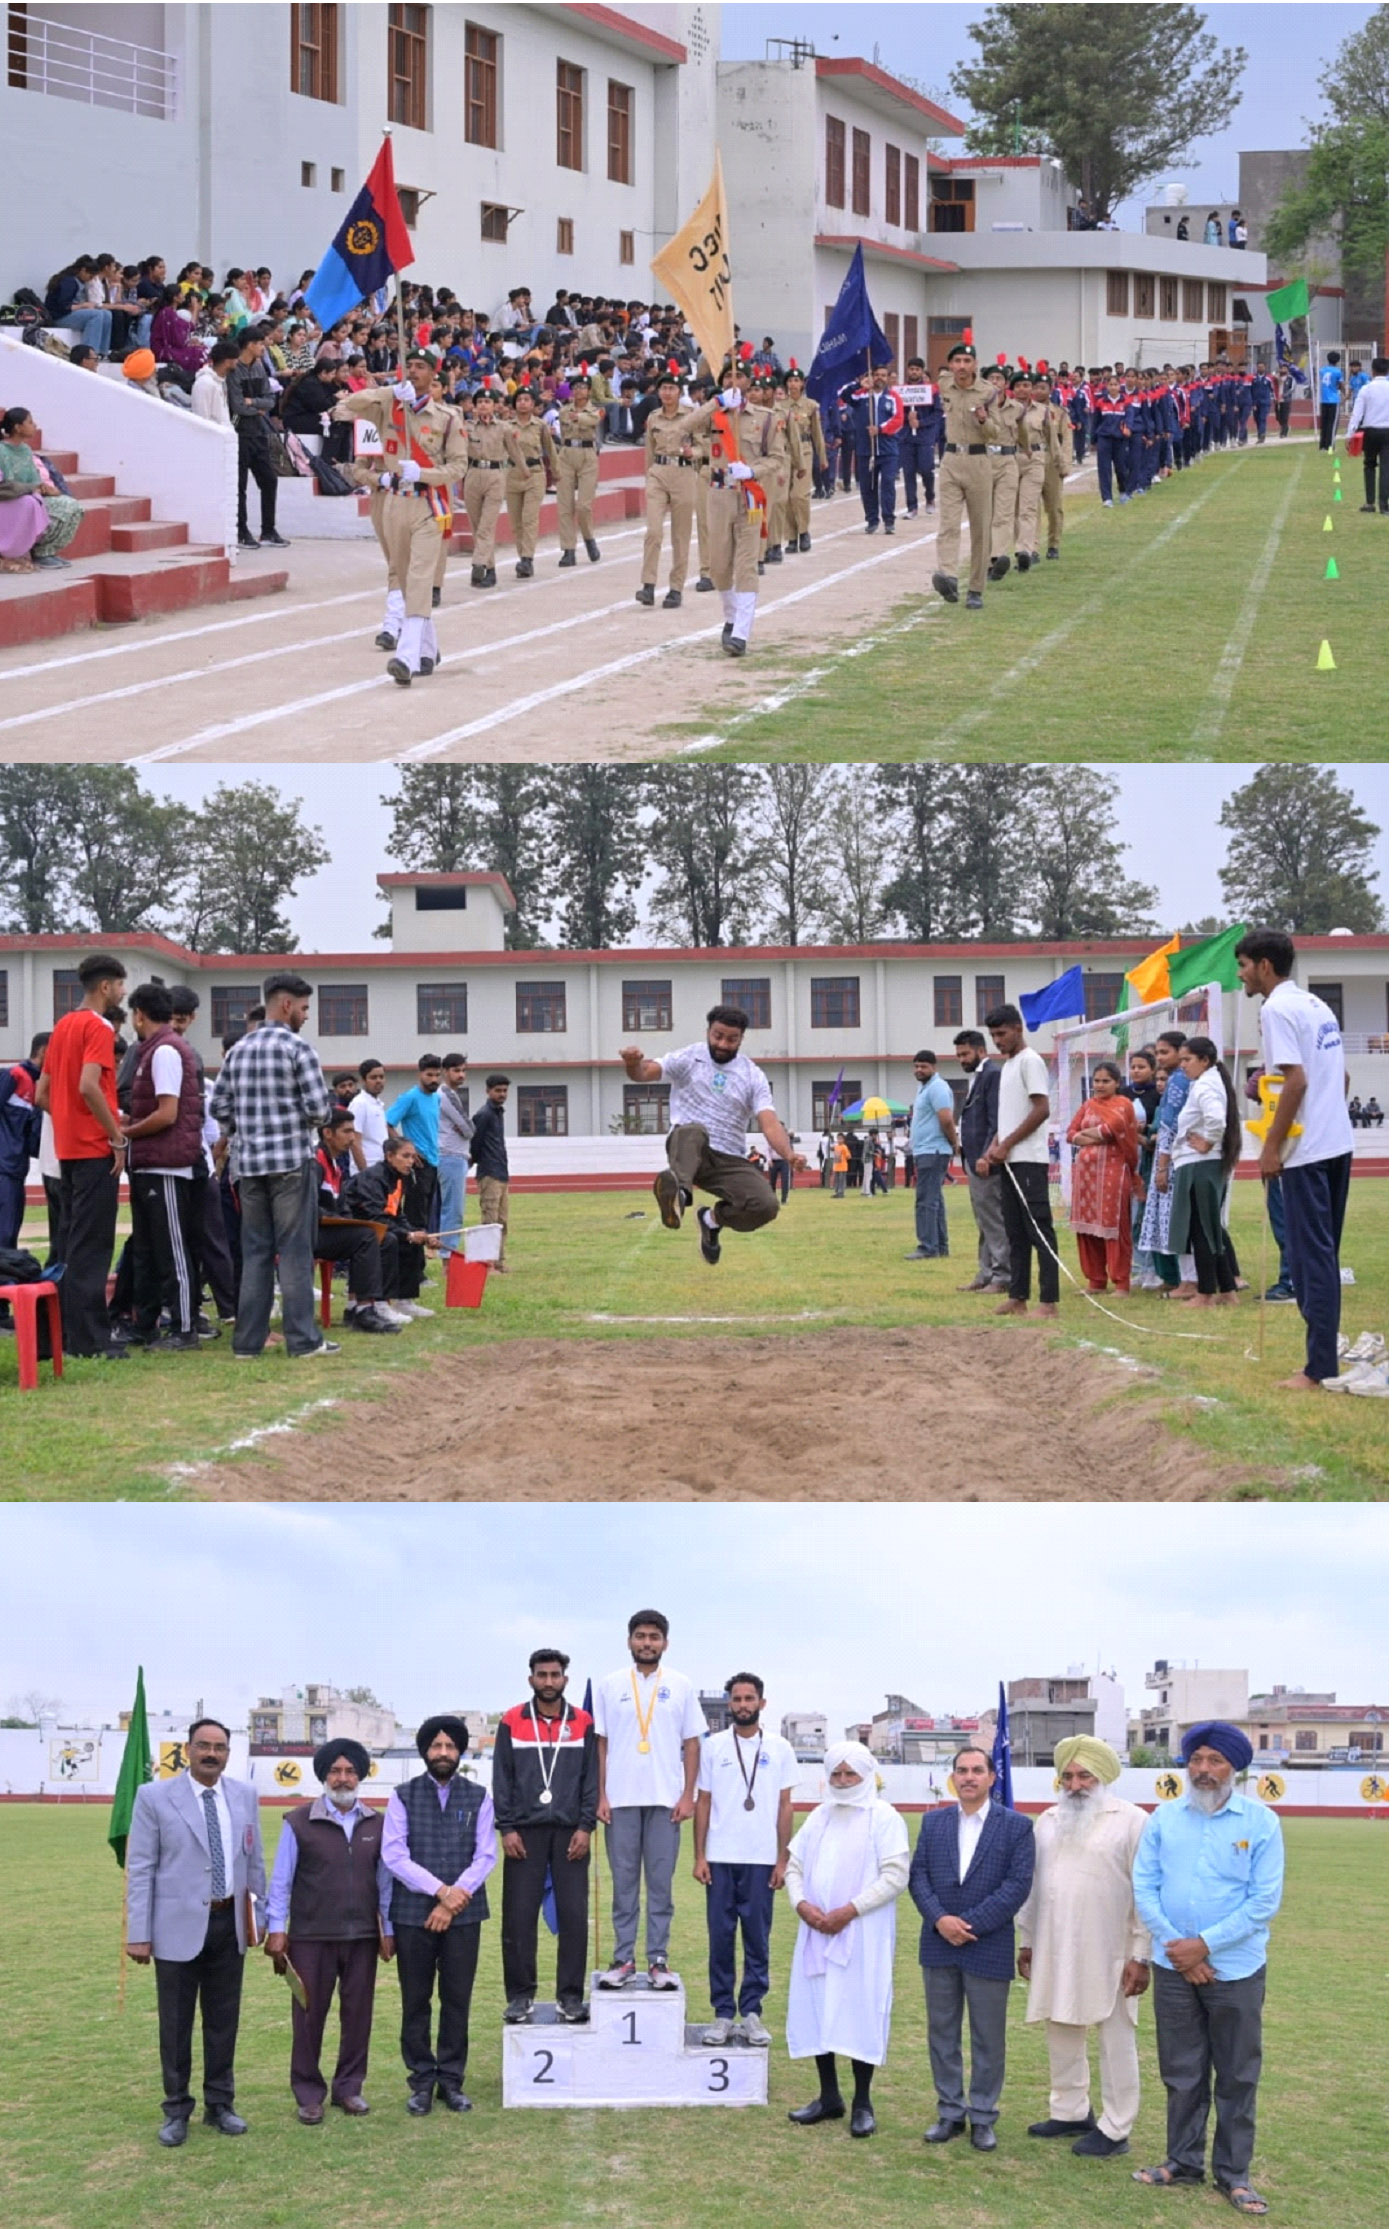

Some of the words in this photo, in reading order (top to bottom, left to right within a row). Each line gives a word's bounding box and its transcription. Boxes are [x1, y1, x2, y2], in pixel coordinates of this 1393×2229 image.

[621, 2011, 642, 2045] 1
[532, 2050, 555, 2084] 2
[707, 2058, 730, 2092] 3
